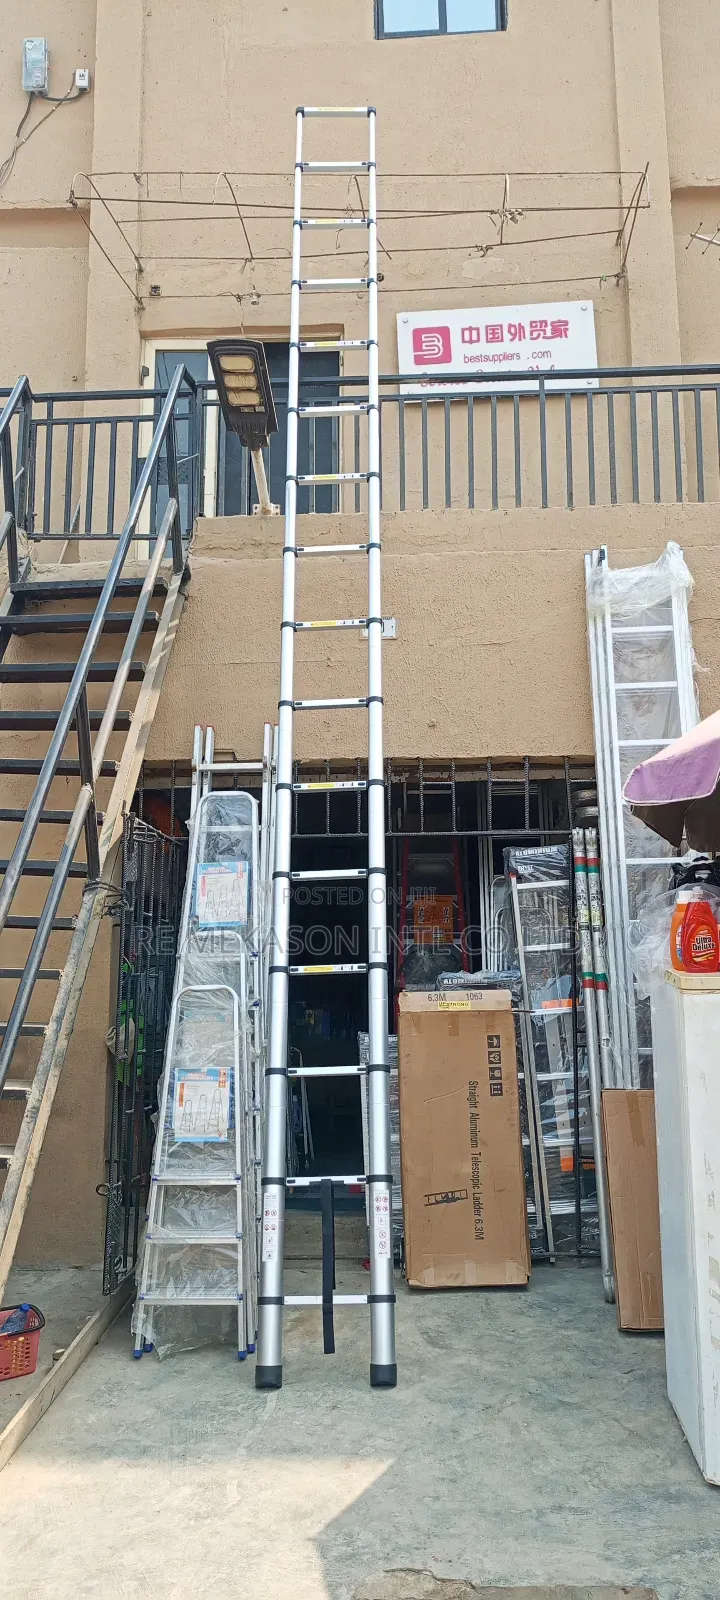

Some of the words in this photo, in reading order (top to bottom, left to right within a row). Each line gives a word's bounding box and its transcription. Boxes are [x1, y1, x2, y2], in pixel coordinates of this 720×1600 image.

[460, 319, 570, 345] 中国外贸家
[463, 351, 521, 364] bestsuppliers
[691, 942, 716, 951] Deluxe
[695, 936, 713, 945] Ultra
[427, 992, 447, 1002] 6.3M
[465, 992, 483, 1001] 1063
[466, 1080, 479, 1108] Straight
[468, 1112, 480, 1148] Aluminum
[470, 1151, 482, 1190] Telescopic
[472, 1191, 482, 1217] Ladder
[473, 1218, 484, 1240] 6.3M
